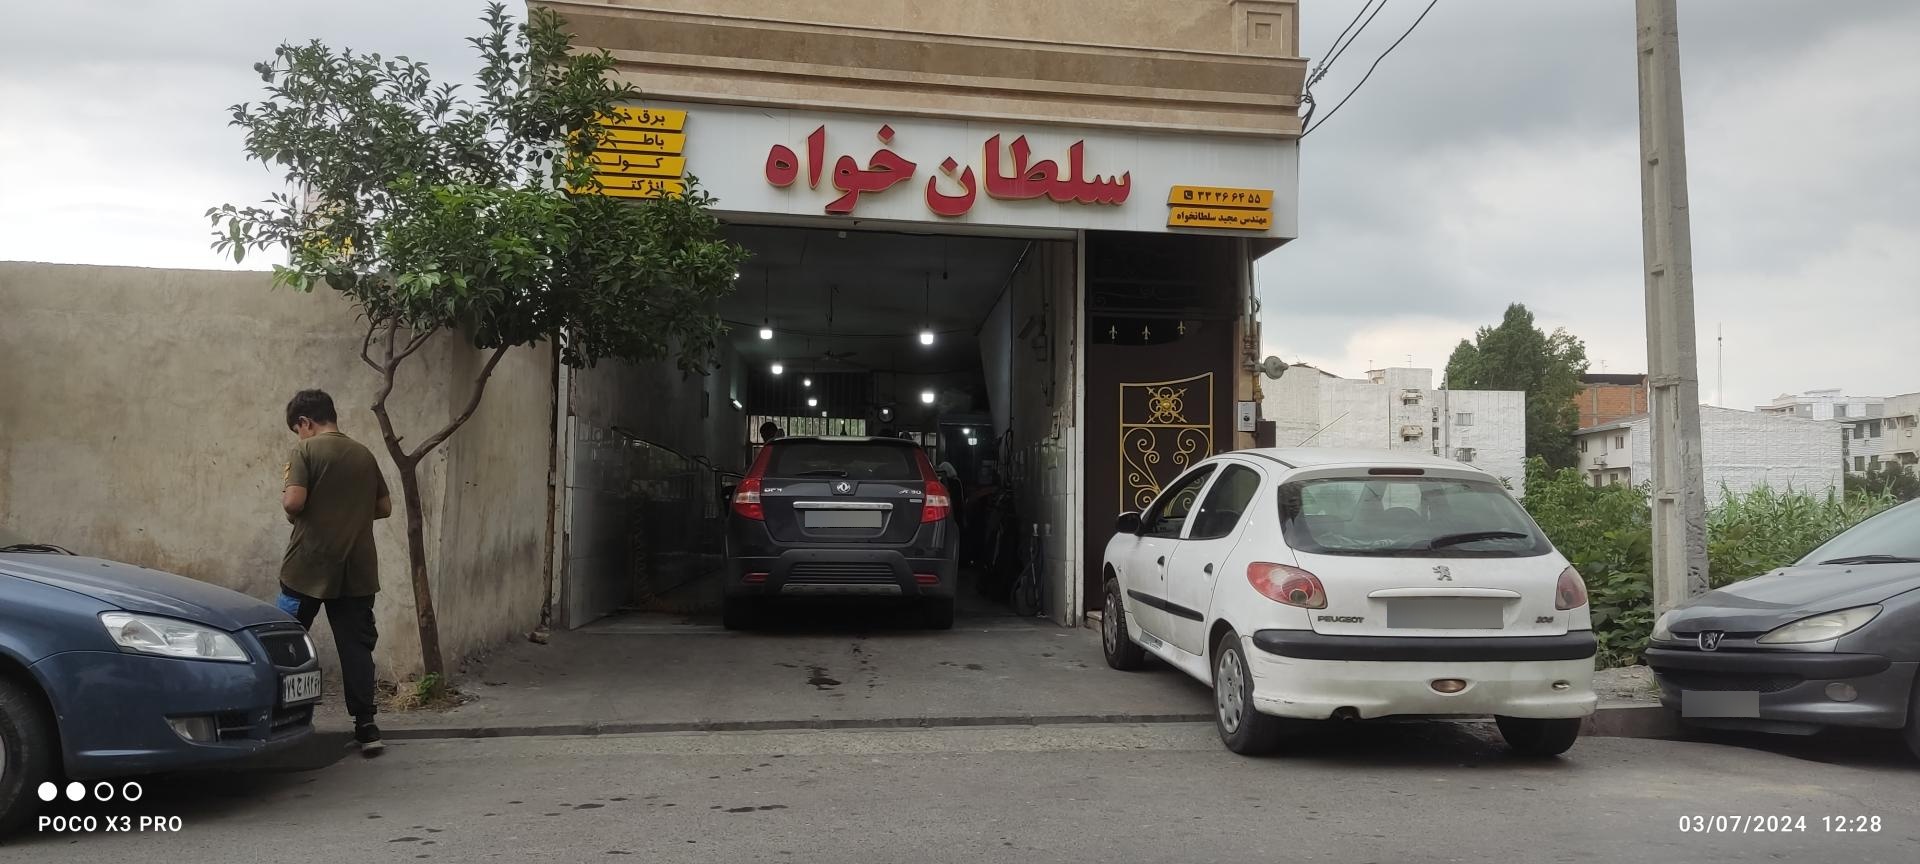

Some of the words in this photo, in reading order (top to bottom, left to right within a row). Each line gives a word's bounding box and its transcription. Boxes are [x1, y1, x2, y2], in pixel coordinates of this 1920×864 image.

[637, 109, 666, 125] برق
[591, 155, 664, 172] کول
[765, 123, 918, 216] خواه
[925, 132, 1132, 217] سلطان
[1247, 193, 1261, 204] ۵۵
[1176, 210, 1217, 223] سلطانخواه
[1218, 213, 1238, 224] مجید
[1239, 215, 1267, 225] مهندس
[1317, 615, 1365, 624] PEUGEOT
[1535, 615, 1554, 624] 206
